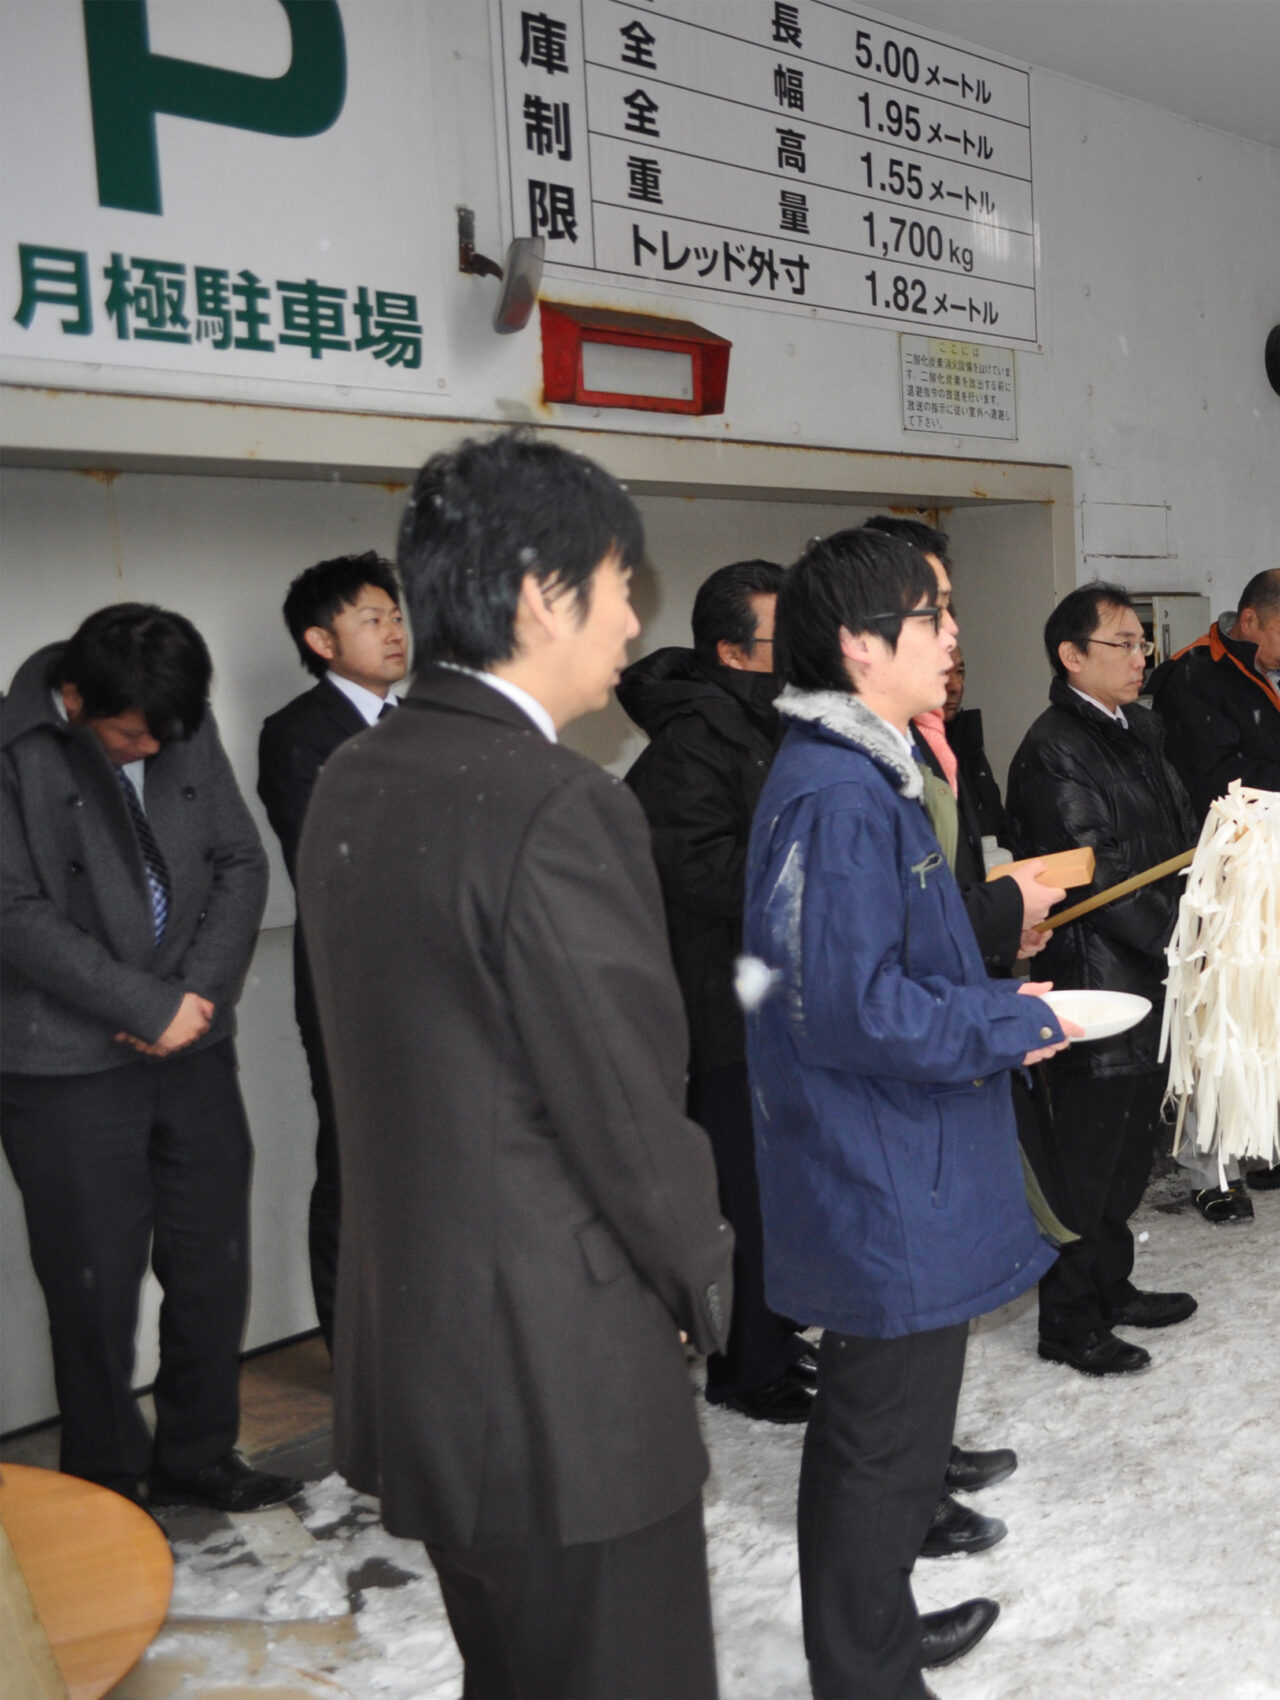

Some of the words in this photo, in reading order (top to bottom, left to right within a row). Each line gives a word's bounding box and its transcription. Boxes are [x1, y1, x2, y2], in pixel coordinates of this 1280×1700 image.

[84, 0, 347, 216] P
[14, 243, 423, 369] 月極駐車場
[632, 224, 810, 295] トレッド外寸
